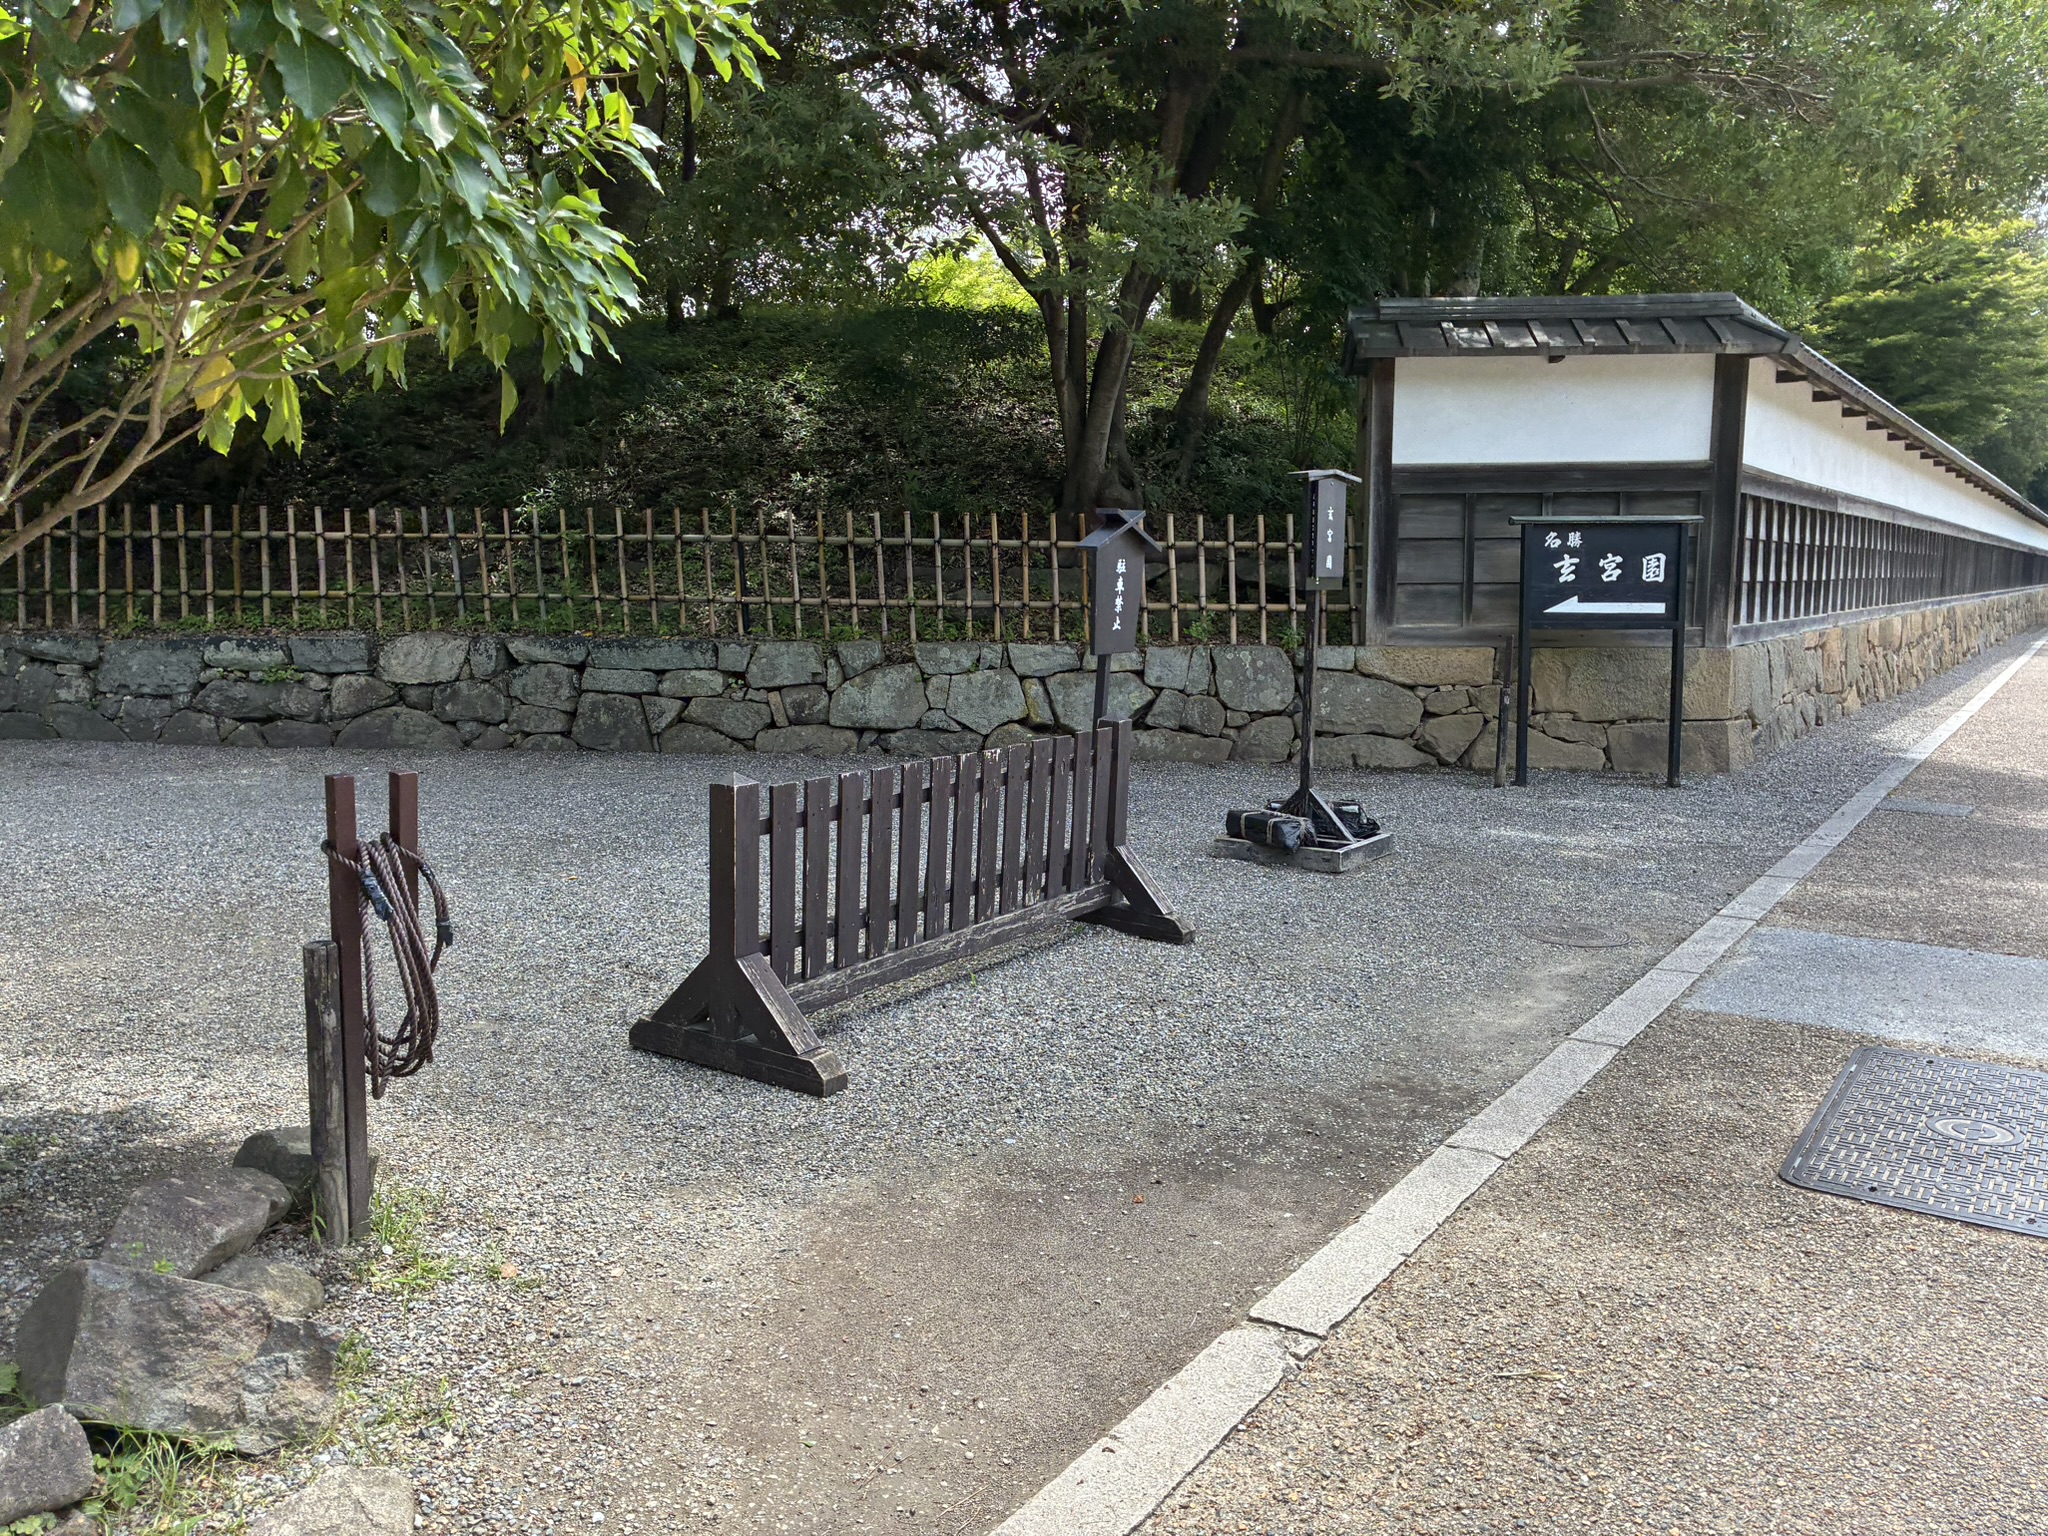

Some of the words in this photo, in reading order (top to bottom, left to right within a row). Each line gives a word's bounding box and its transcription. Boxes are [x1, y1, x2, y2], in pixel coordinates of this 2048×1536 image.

[1545, 531, 1583, 548] 名勝
[1553, 553, 1666, 583] 玄宮園
[1112, 558, 1126, 631] 駐車禁止
